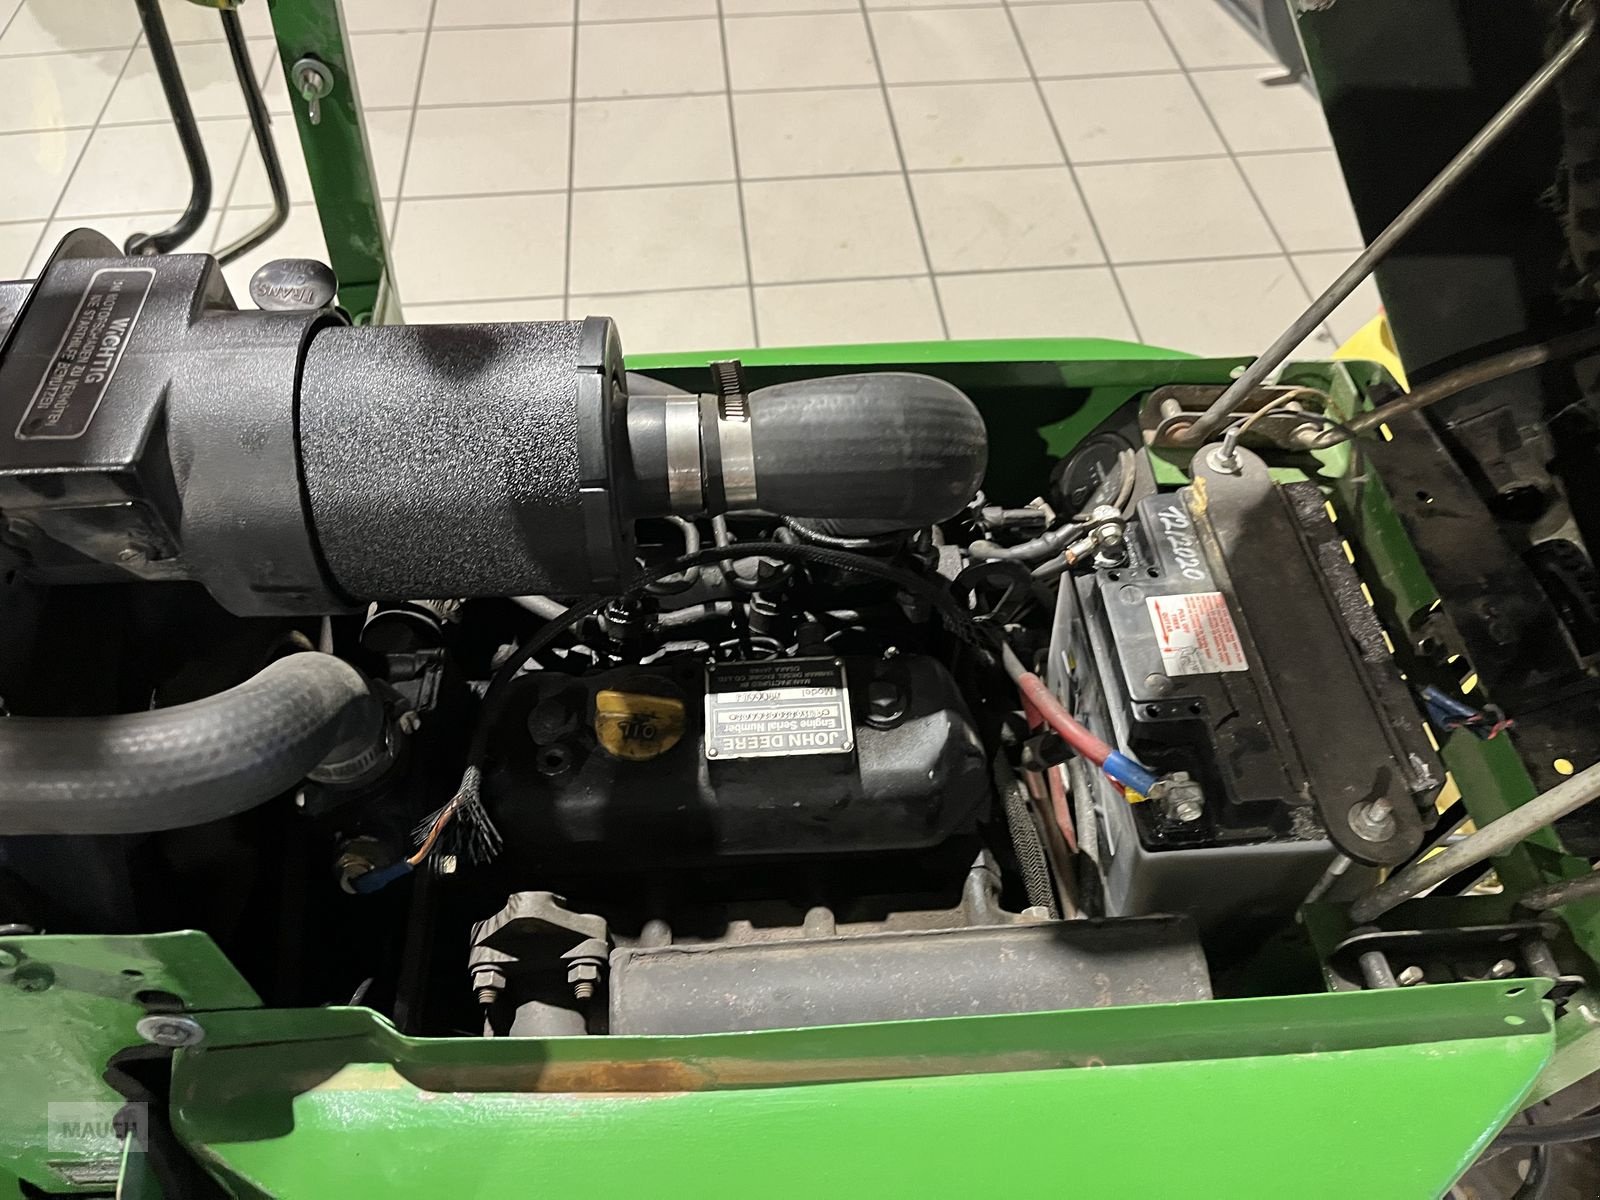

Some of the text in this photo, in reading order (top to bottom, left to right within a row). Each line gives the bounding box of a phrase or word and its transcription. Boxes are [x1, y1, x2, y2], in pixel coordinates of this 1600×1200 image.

[280, 271, 306, 284] OIL
[257, 283, 314, 304] TRANS
[84, 317, 131, 384] WICHTIG
[70, 364, 86, 377] ZU
[801, 687, 835, 697] Model
[723, 718, 836, 732] Engine Serial Number
[723, 732, 839, 750] JOHN DEERE
